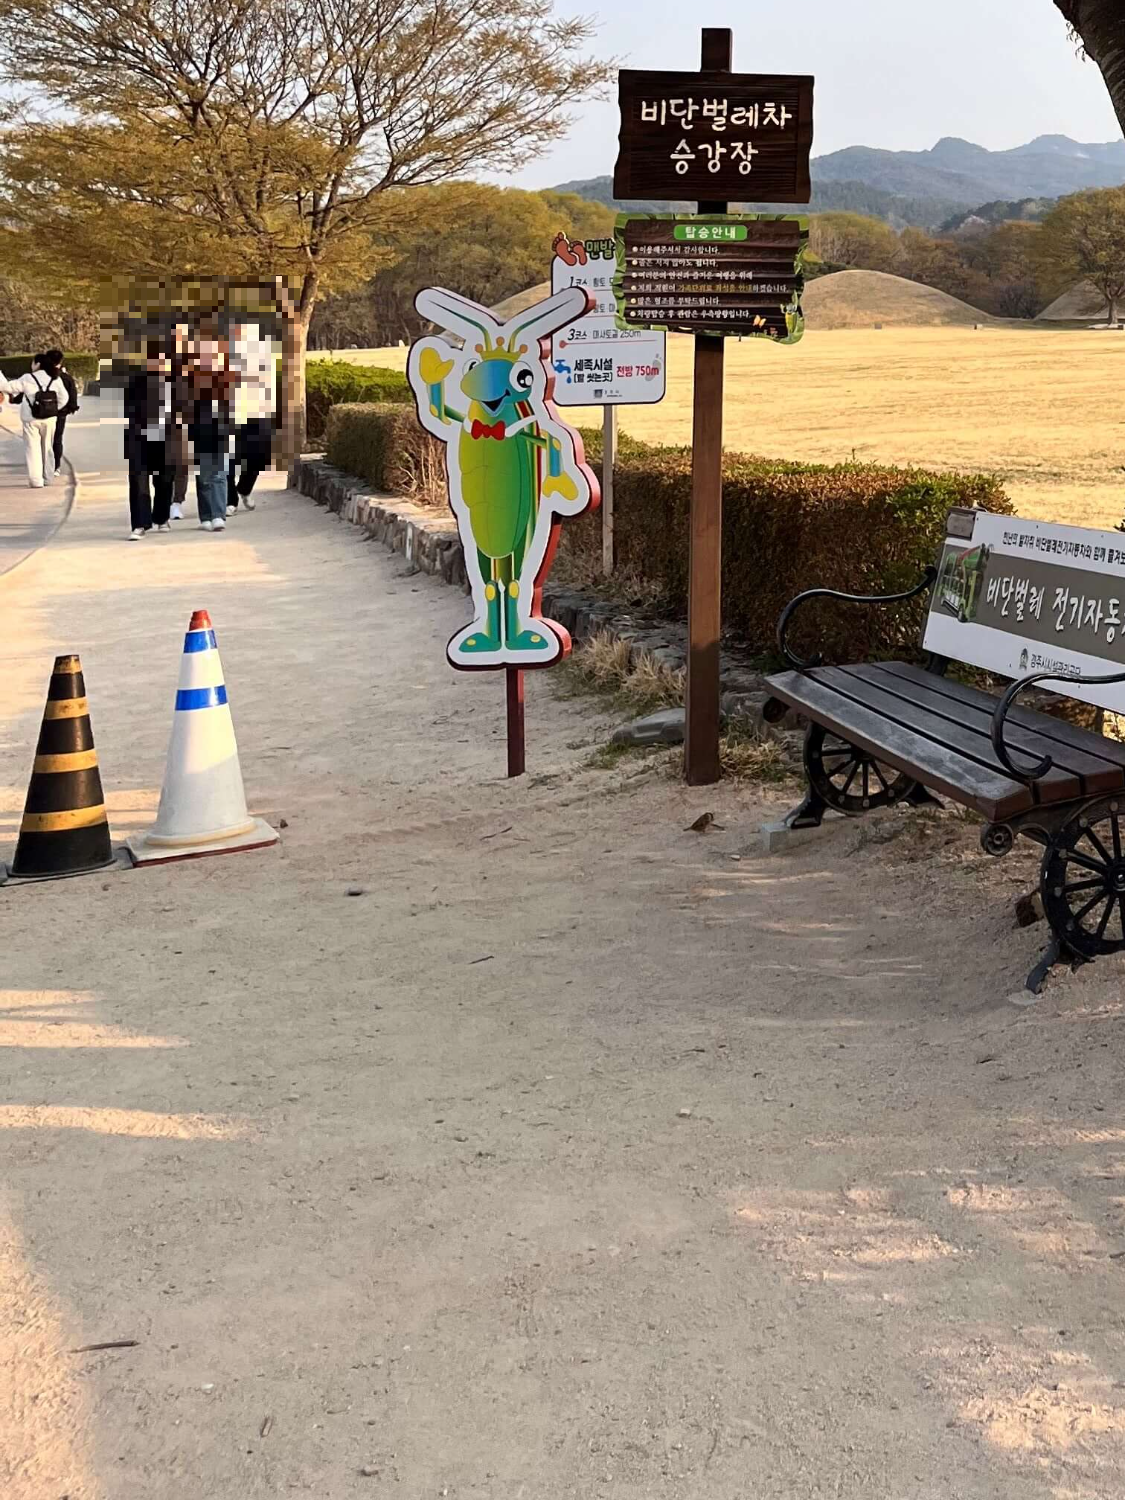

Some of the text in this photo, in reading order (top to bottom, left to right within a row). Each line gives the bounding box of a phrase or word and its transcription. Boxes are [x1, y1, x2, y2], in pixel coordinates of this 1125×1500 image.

[641, 97, 793, 132] 비단벌레차
[670, 138, 759, 175] 승강장
[685, 226, 736, 239] 탑승안내
[684, 245, 720, 255] 감사합니다.
[567, 328, 588, 340] 3코스
[574, 358, 659, 378] 세족시설 전방 750m
[1093, 546, 1106, 562] 함께
[986, 575, 1045, 622] 비단벌레
